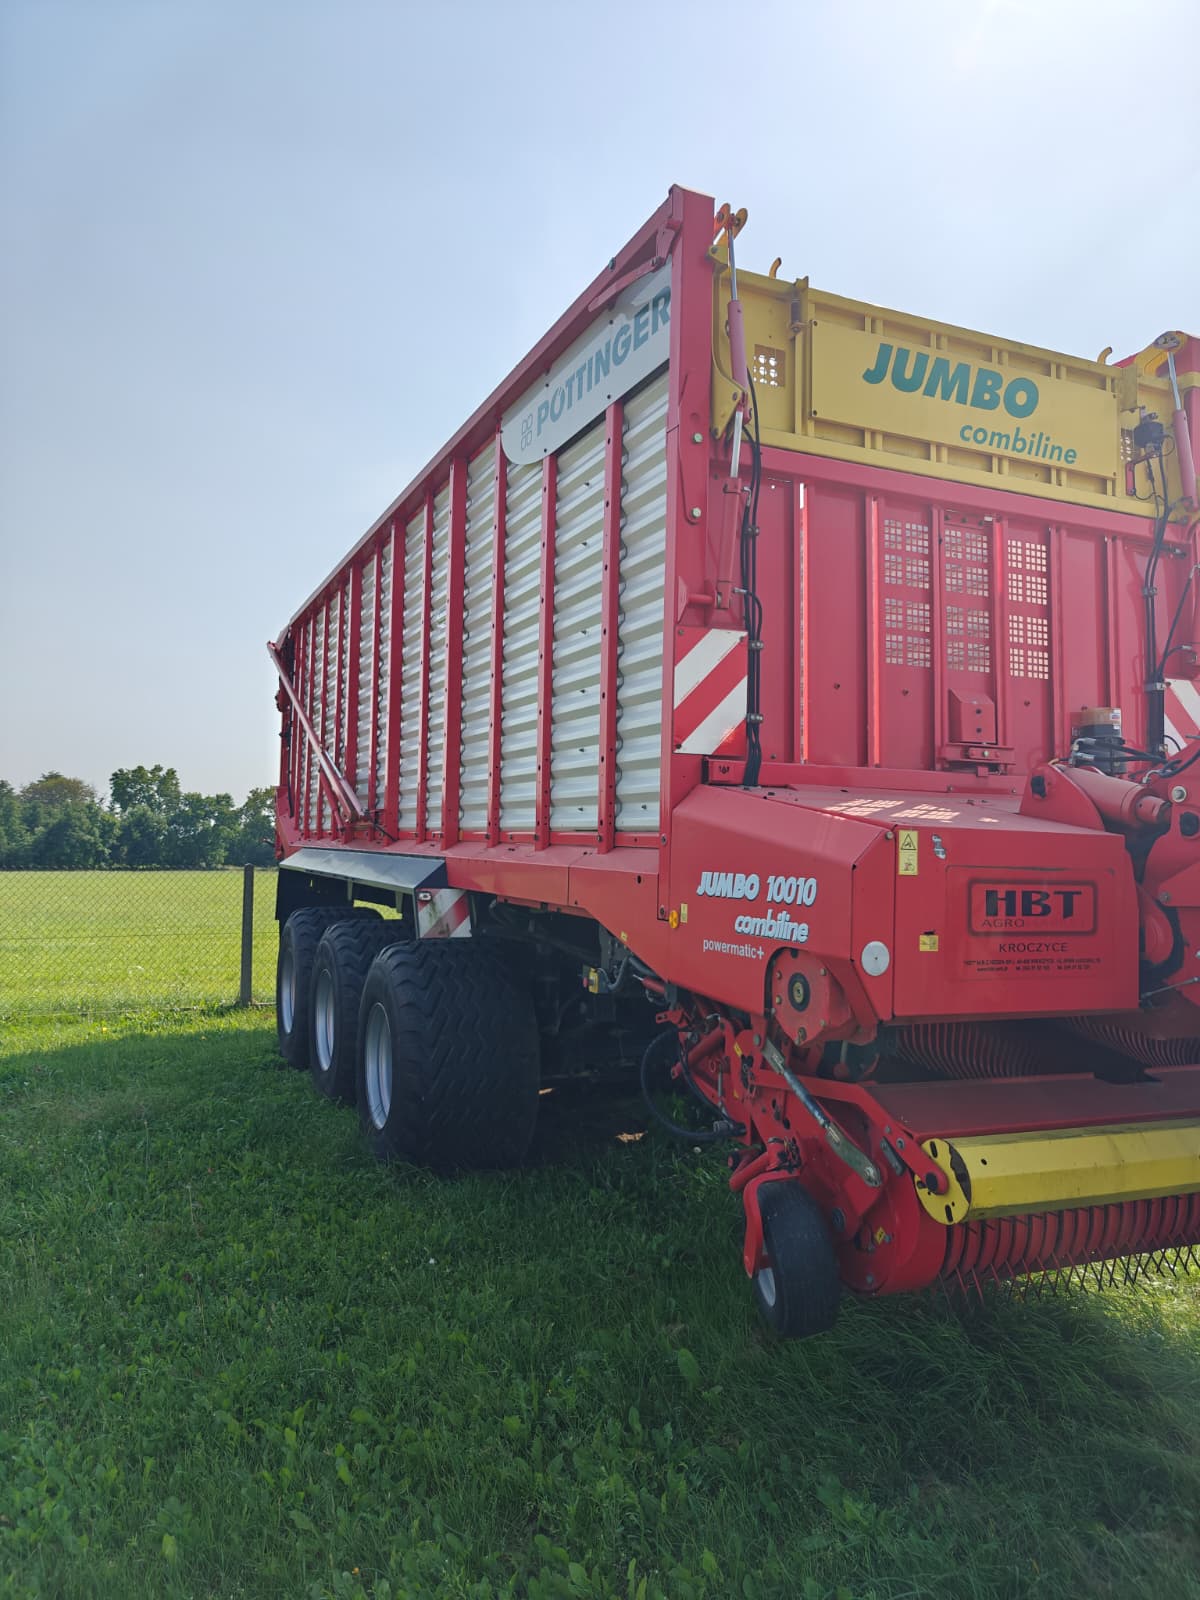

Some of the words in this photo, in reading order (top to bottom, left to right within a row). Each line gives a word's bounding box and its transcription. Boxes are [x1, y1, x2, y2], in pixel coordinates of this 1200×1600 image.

[862, 342, 1039, 419] JUMBO
[959, 424, 1078, 465] combiline
[696, 871, 760, 901] JUMBO
[766, 875, 817, 906] 10010
[985, 889, 1082, 920] HBT
[734, 909, 809, 943] combiline
[981, 918, 1025, 928] AGRO
[702, 938, 765, 960] powermatic+
[998, 942, 1070, 953] KROCZYCE
